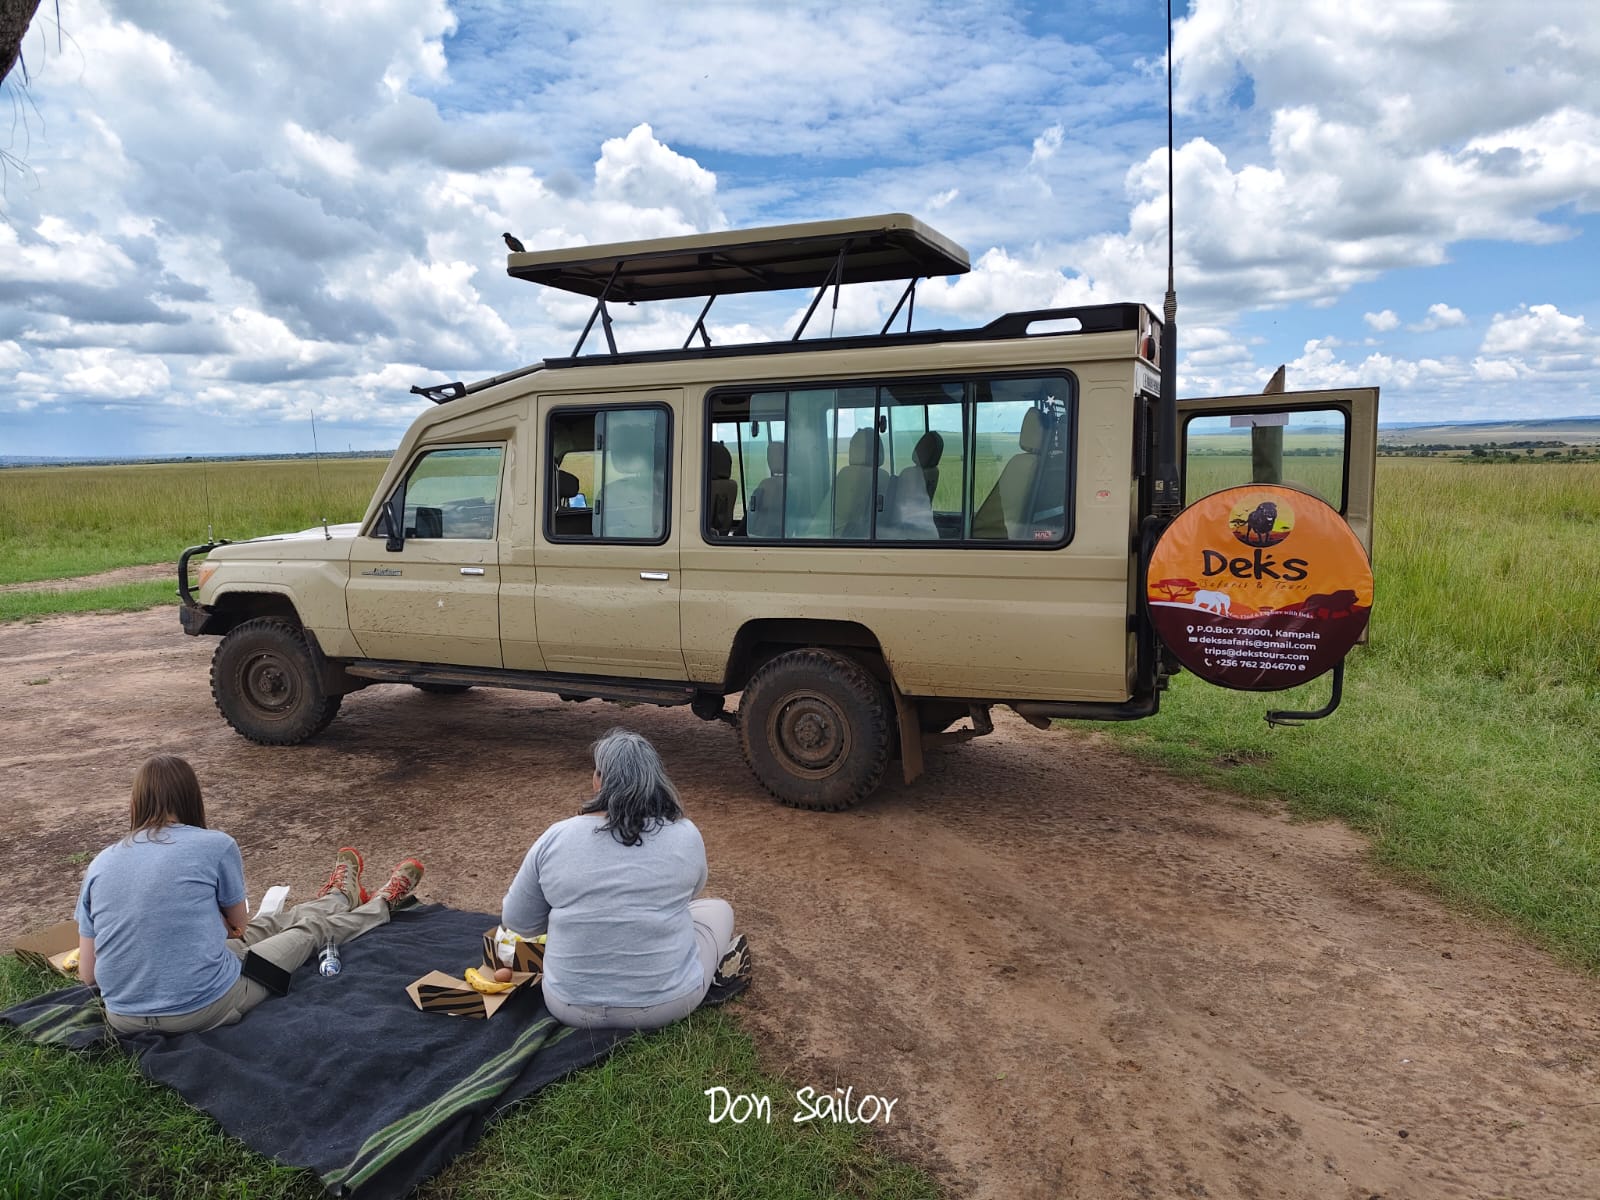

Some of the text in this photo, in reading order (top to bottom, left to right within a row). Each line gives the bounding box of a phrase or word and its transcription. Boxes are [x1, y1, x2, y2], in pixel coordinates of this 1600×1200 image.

[1256, 581, 1263, 589] &
[1271, 581, 1310, 591] Tours
[1284, 609, 1298, 617] with
[1196, 625, 1321, 640] P.O.Box 730001, Kampala
[1199, 635, 1317, 651] dekssafaris@gmail.com
[1204, 646, 1310, 661] trips@dekstours.com
[1215, 659, 1297, 671] +256 762 204670
